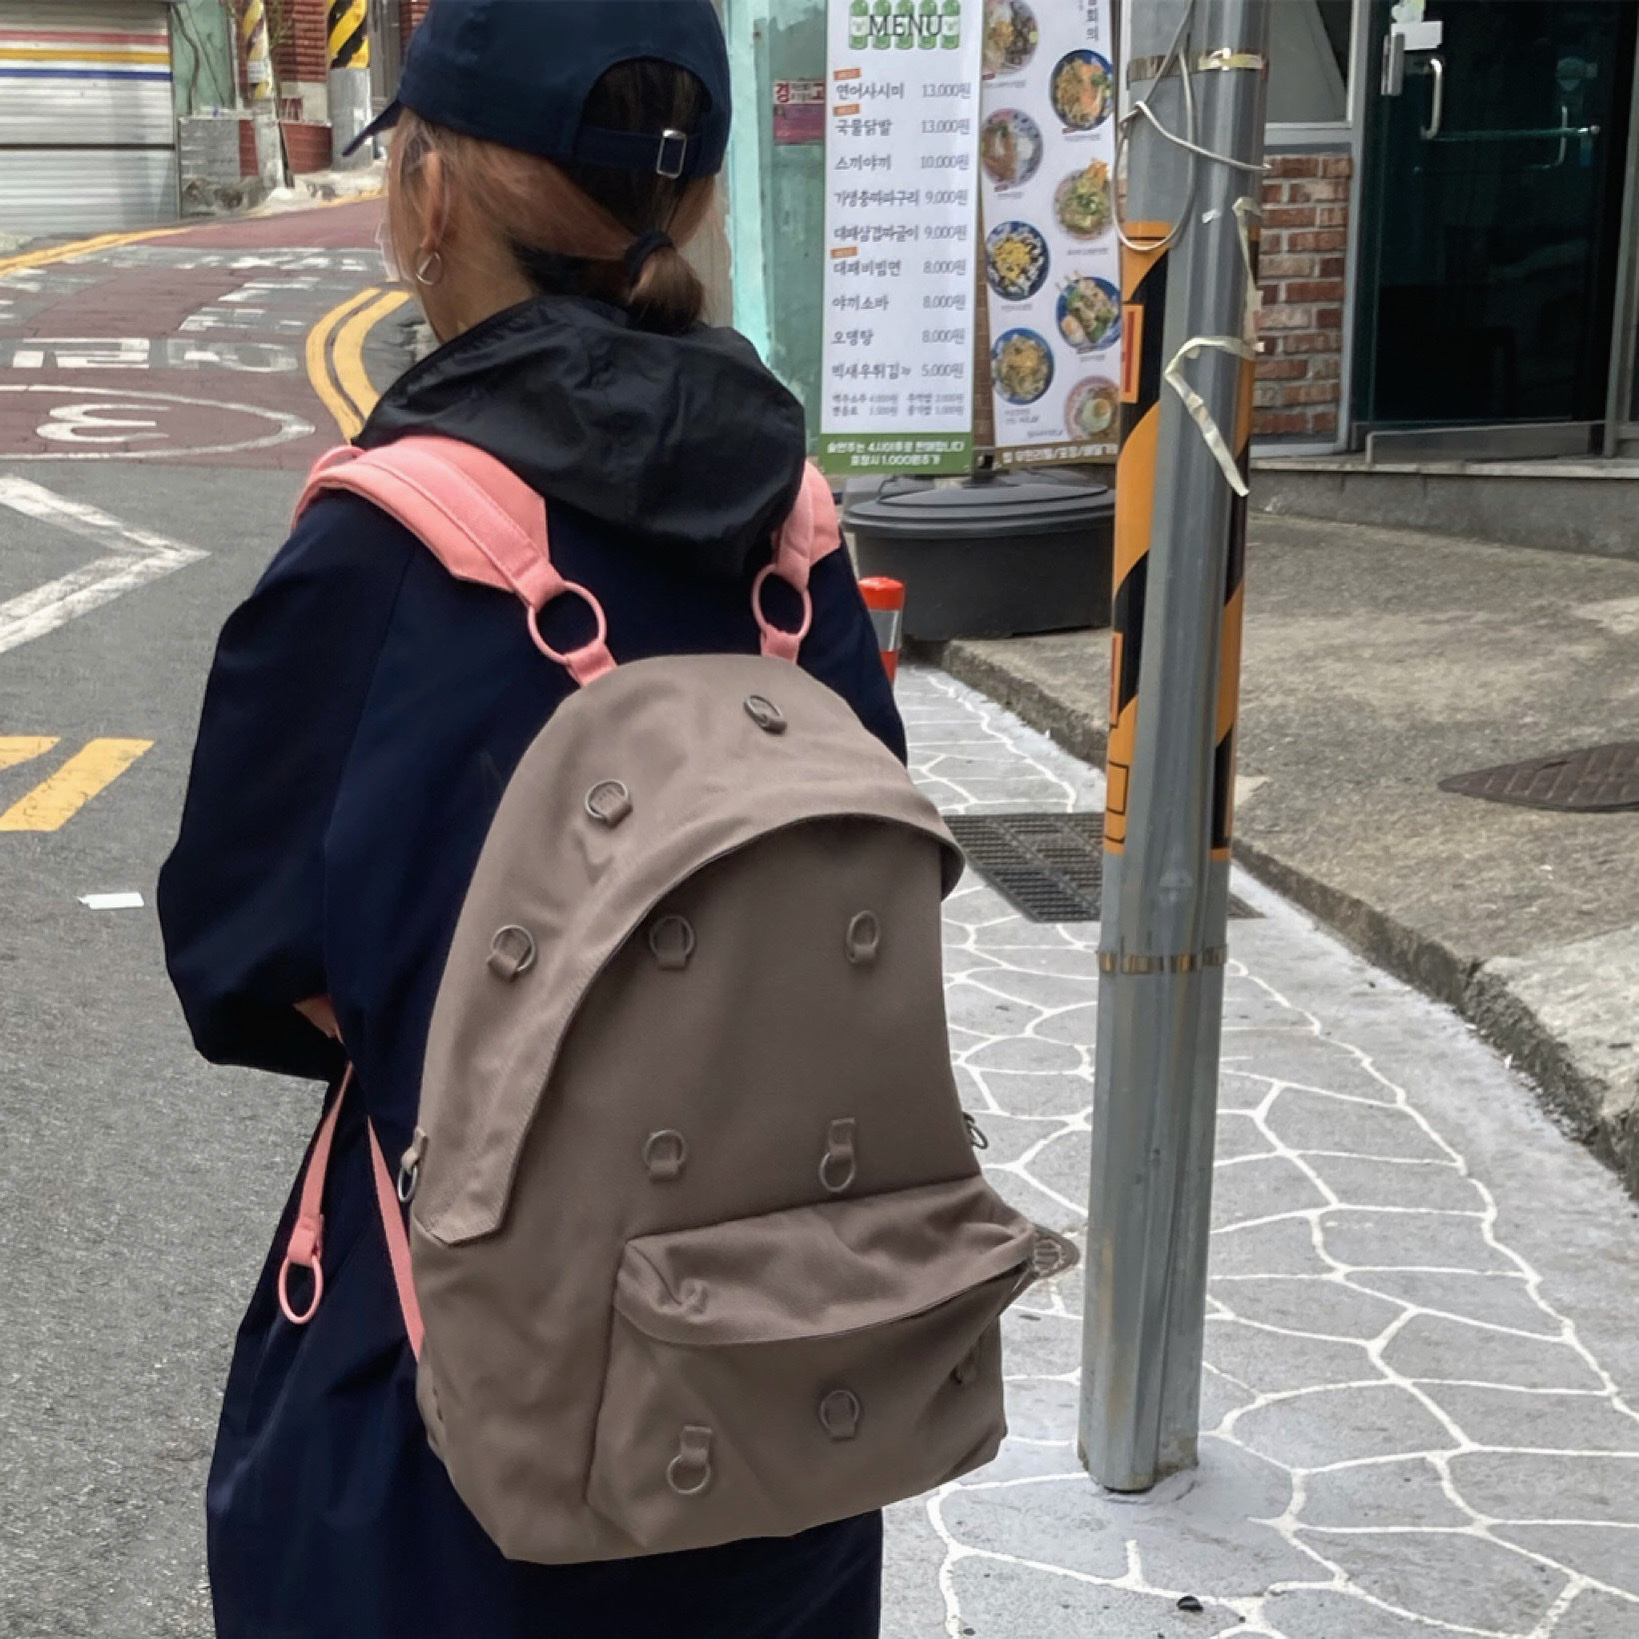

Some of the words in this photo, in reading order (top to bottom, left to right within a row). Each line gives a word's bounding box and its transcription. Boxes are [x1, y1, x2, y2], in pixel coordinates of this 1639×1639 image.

[868, 14, 942, 36] MENU
[836, 81, 905, 101] 연어사시미
[835, 118, 893, 136] 국물닭발
[834, 154, 891, 171] 스끼야끼
[832, 258, 902, 277] 대패비빔면
[832, 294, 889, 311] 야끼소바
